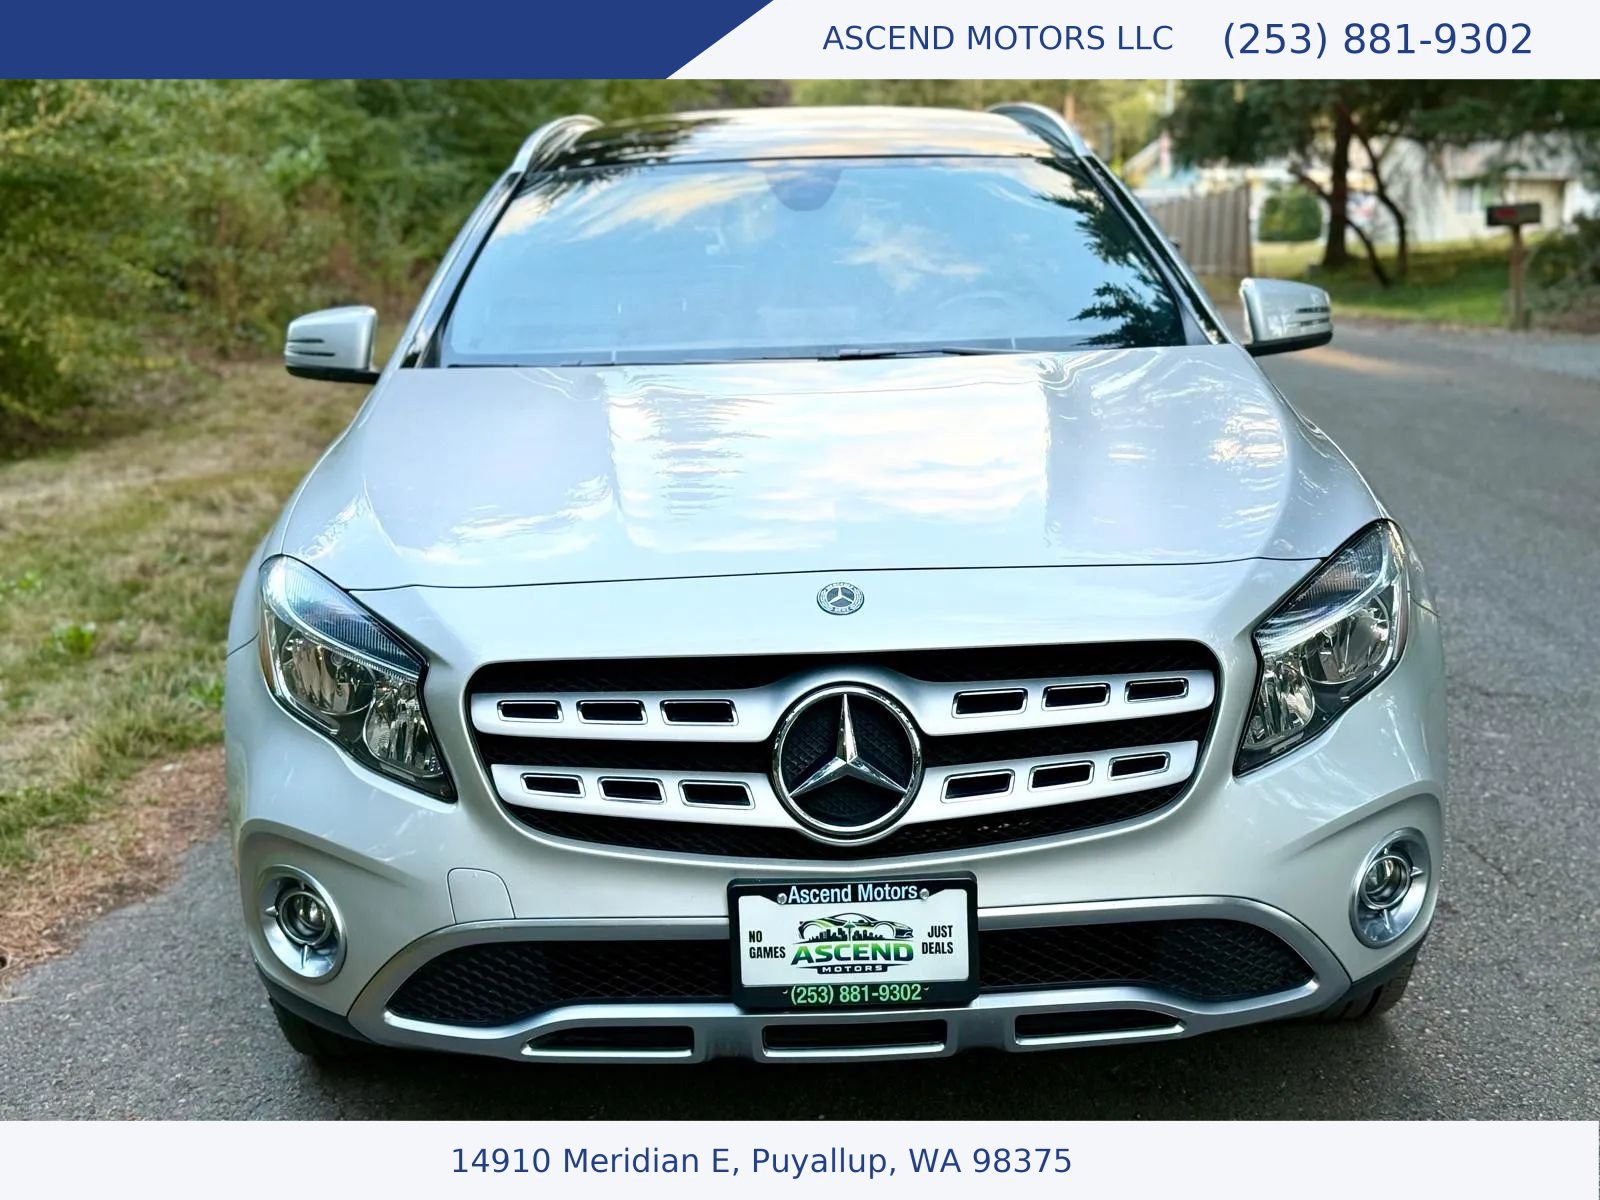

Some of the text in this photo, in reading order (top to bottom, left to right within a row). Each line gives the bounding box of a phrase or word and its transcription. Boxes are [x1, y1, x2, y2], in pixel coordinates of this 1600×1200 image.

[788, 883, 918, 905] Ascend Motors
[749, 930, 763, 943] NO
[927, 925, 953, 938] JUST
[749, 946, 786, 959] GAMES
[790, 942, 914, 965] ASCEND
[921, 941, 954, 955] DEALS
[821, 964, 883, 973] MOTORS
[791, 983, 922, 1005] (253) 881-9302
